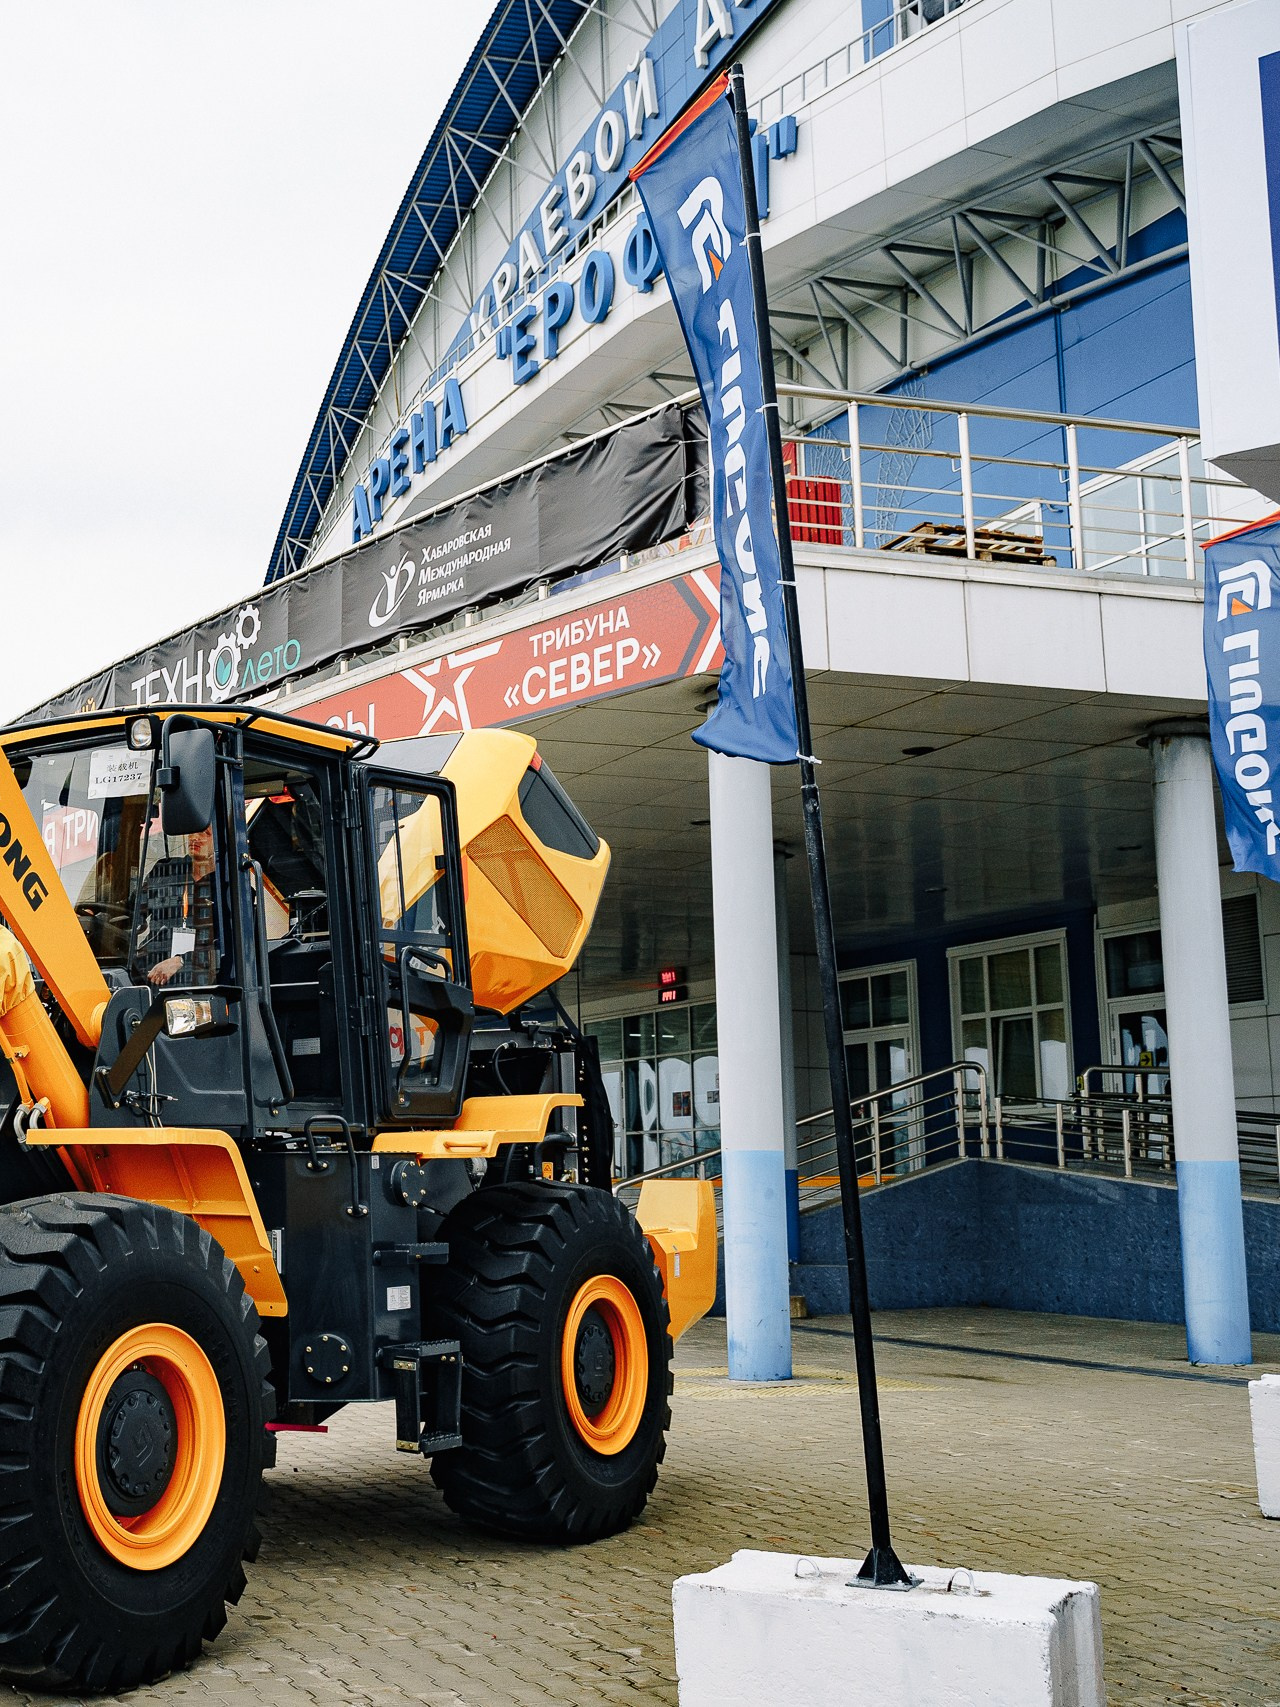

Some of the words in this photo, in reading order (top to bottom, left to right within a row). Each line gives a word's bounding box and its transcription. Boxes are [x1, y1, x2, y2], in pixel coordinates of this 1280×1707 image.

[470, 50, 660, 350] КРАЕВОЙ
[352, 378, 468, 544] АРЕНА
[529, 606, 630, 658] ТРИБУНА
[503, 637, 662, 709] «СЕВЕР»
[95, 773, 143, 784] LG17237
